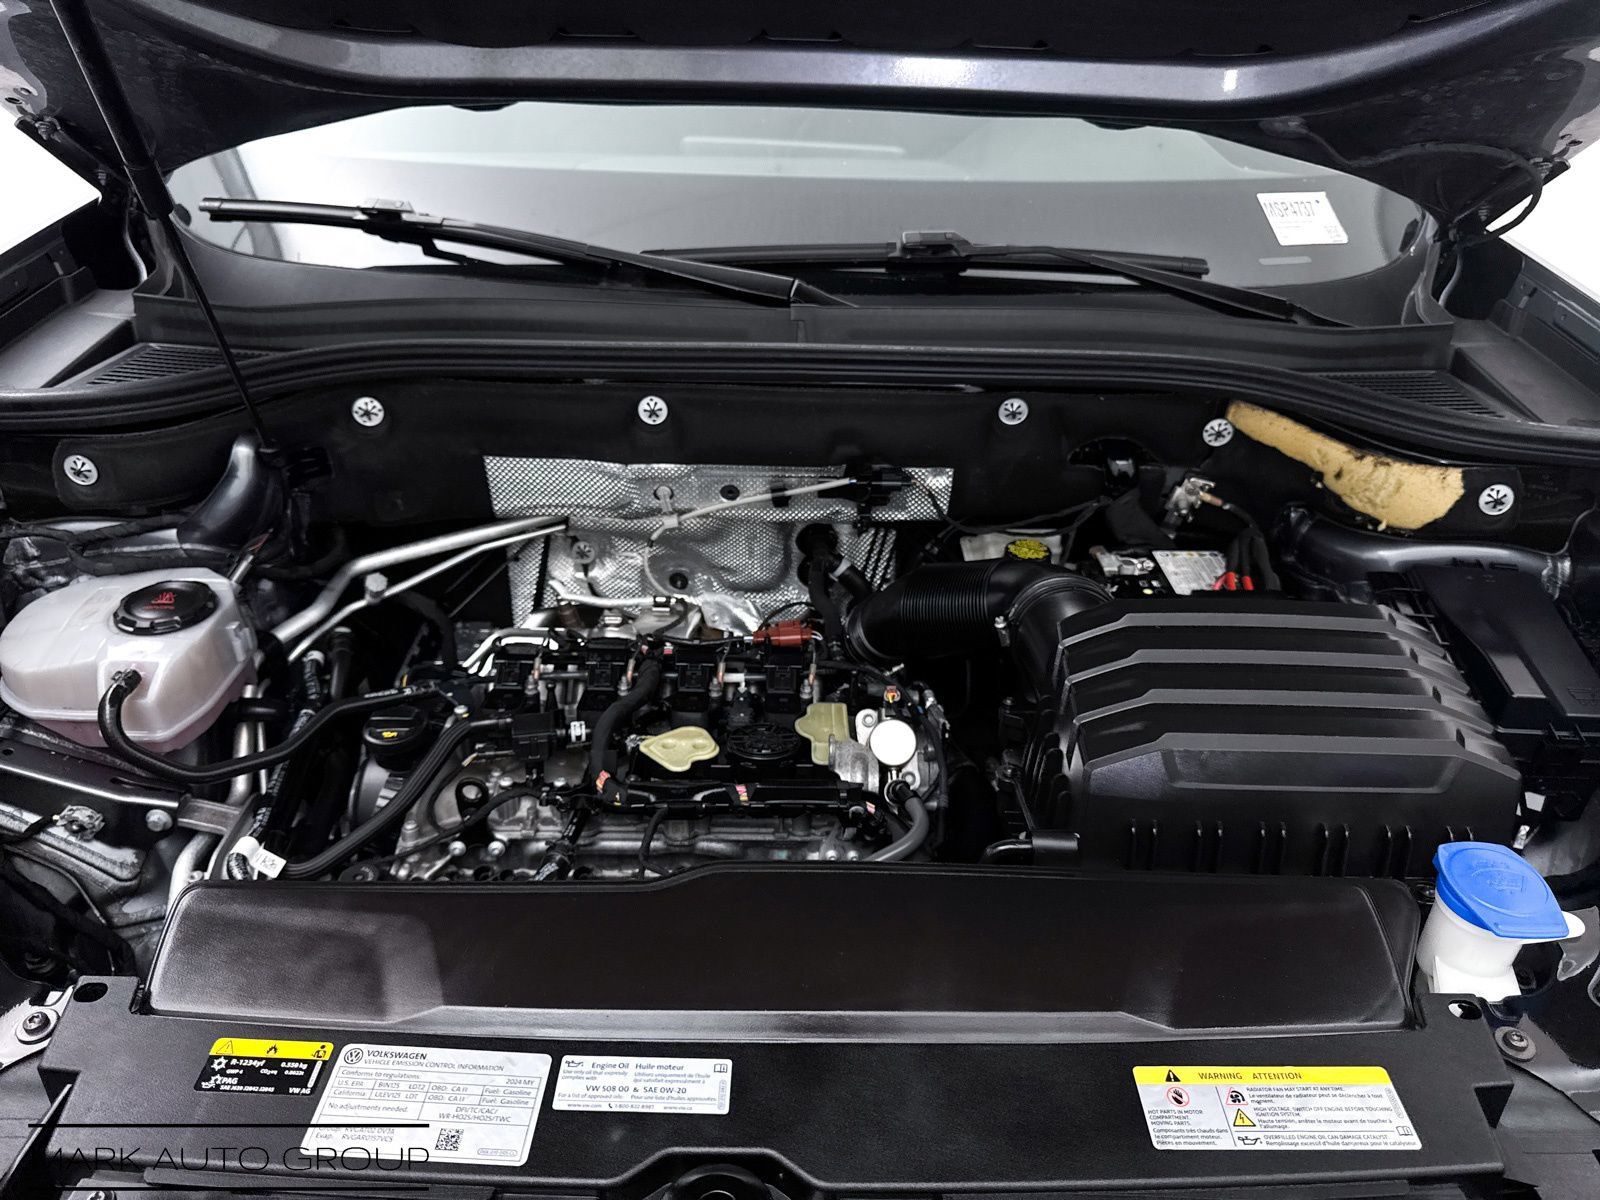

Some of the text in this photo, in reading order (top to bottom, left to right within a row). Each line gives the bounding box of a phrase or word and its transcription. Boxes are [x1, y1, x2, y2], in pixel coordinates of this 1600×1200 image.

[367, 1050, 427, 1060] VOLKSWAGEN
[230, 1059, 266, 1068] R-1234yf
[457, 1063, 504, 1071] INFORMATION
[592, 1062, 617, 1070] Engine
[1198, 1072, 1302, 1080] WARNING ATTENTION
[339, 1103, 380, 1112] adjustments
